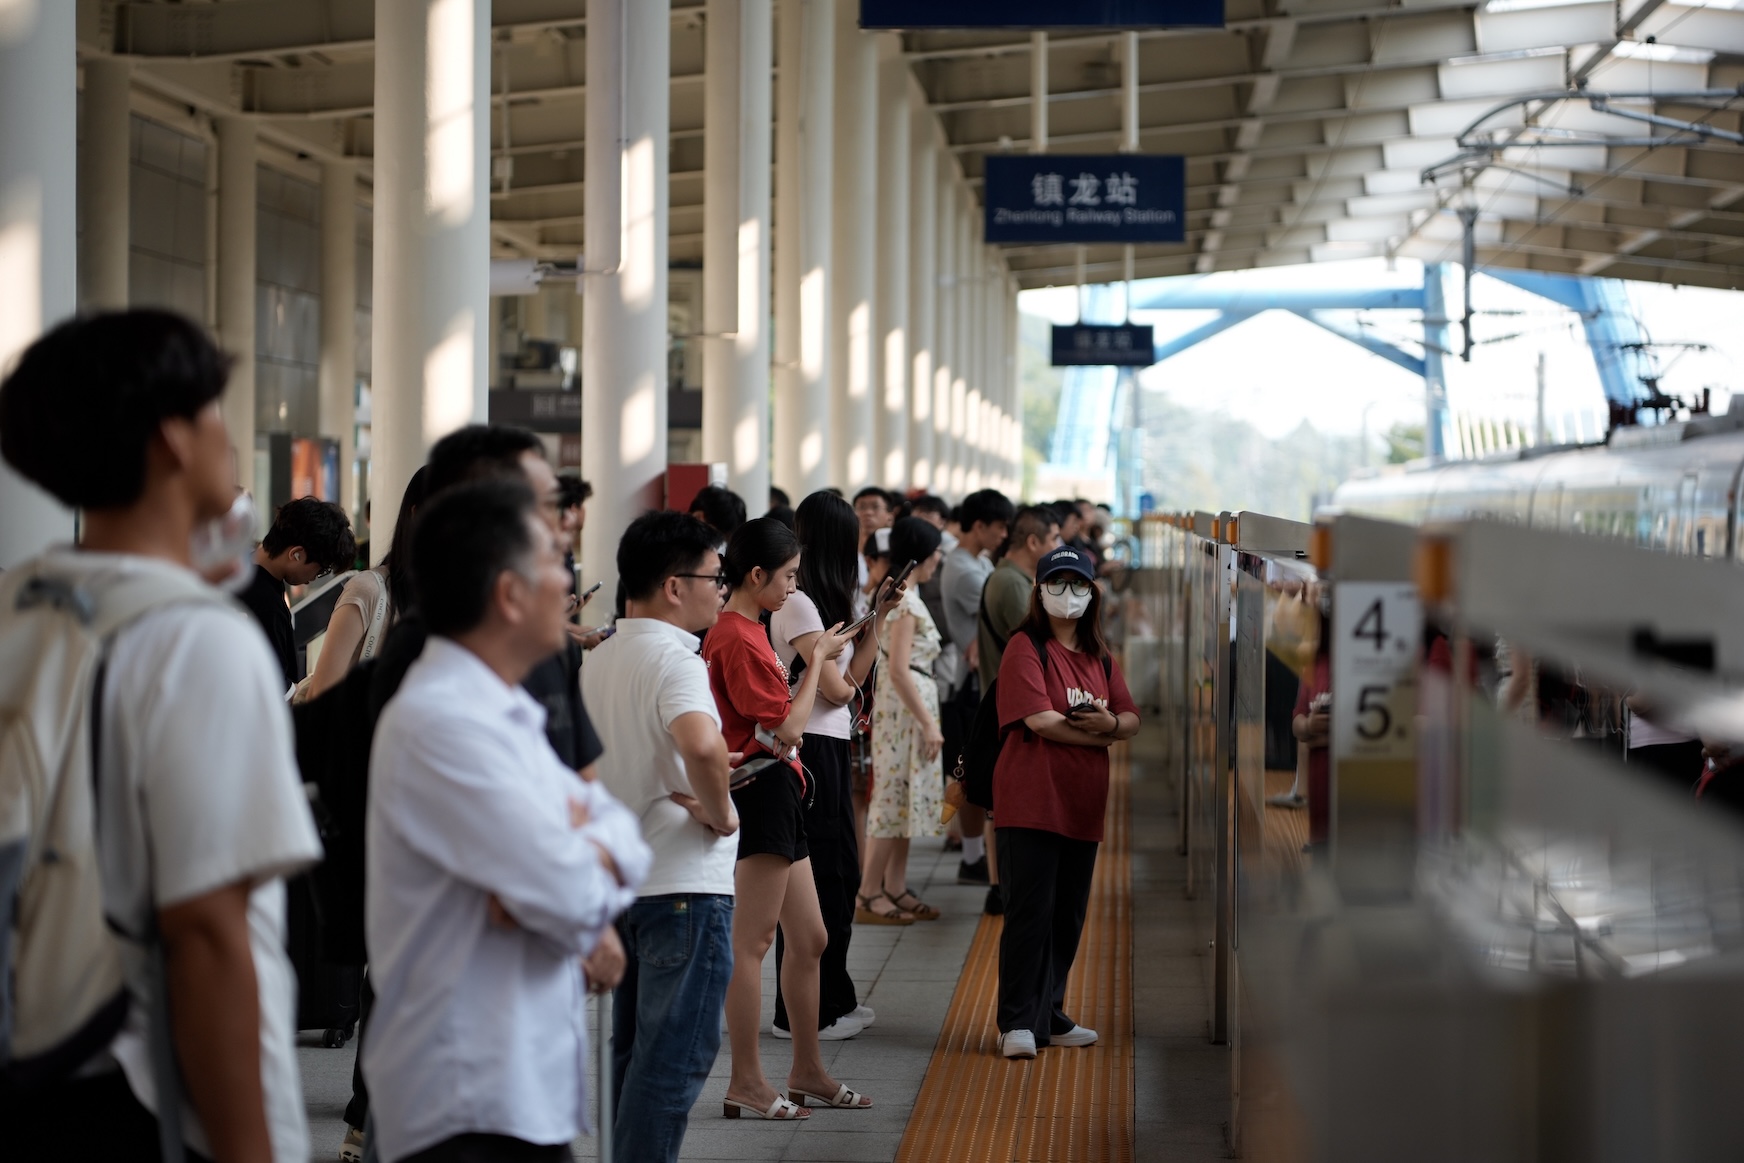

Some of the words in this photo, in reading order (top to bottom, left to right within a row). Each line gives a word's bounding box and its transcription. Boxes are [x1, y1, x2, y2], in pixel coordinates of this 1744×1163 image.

[1032, 172, 1139, 206] 镇龙站
[1066, 208, 1121, 227] Railway
[1124, 207, 1176, 225] Station
[1352, 597, 1390, 651] 4
[1356, 685, 1391, 741] 5
